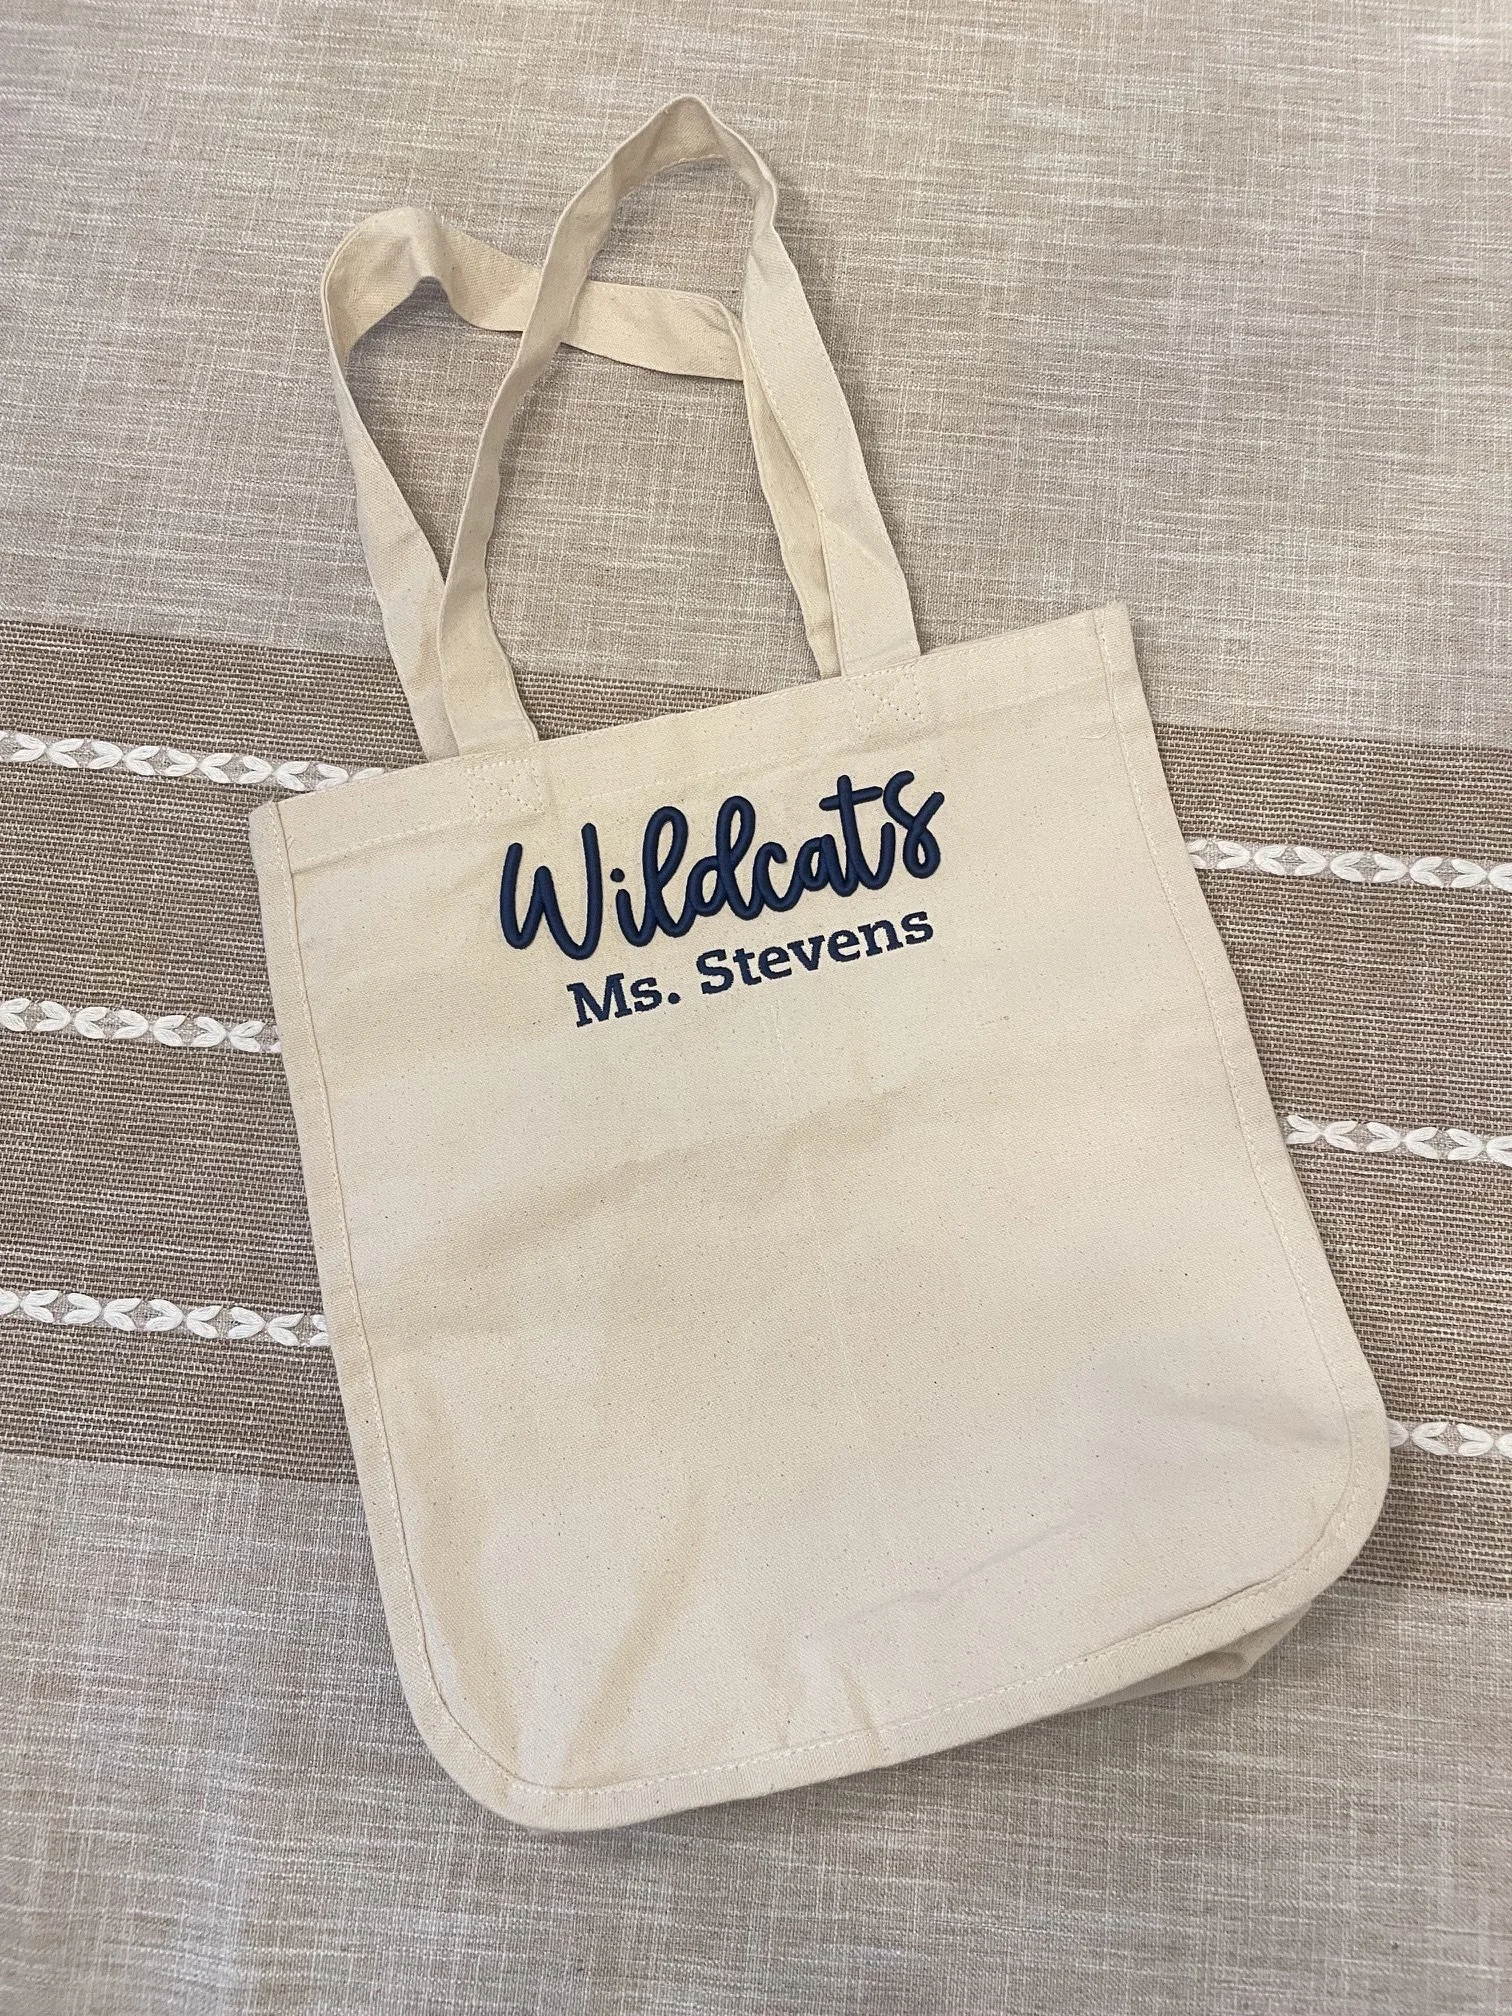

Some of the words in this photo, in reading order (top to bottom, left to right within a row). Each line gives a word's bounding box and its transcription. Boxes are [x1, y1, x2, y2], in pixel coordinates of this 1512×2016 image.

[499, 769, 945, 961] Wildcats
[566, 972, 682, 1028] Ms.
[695, 910, 934, 996] Stevens
